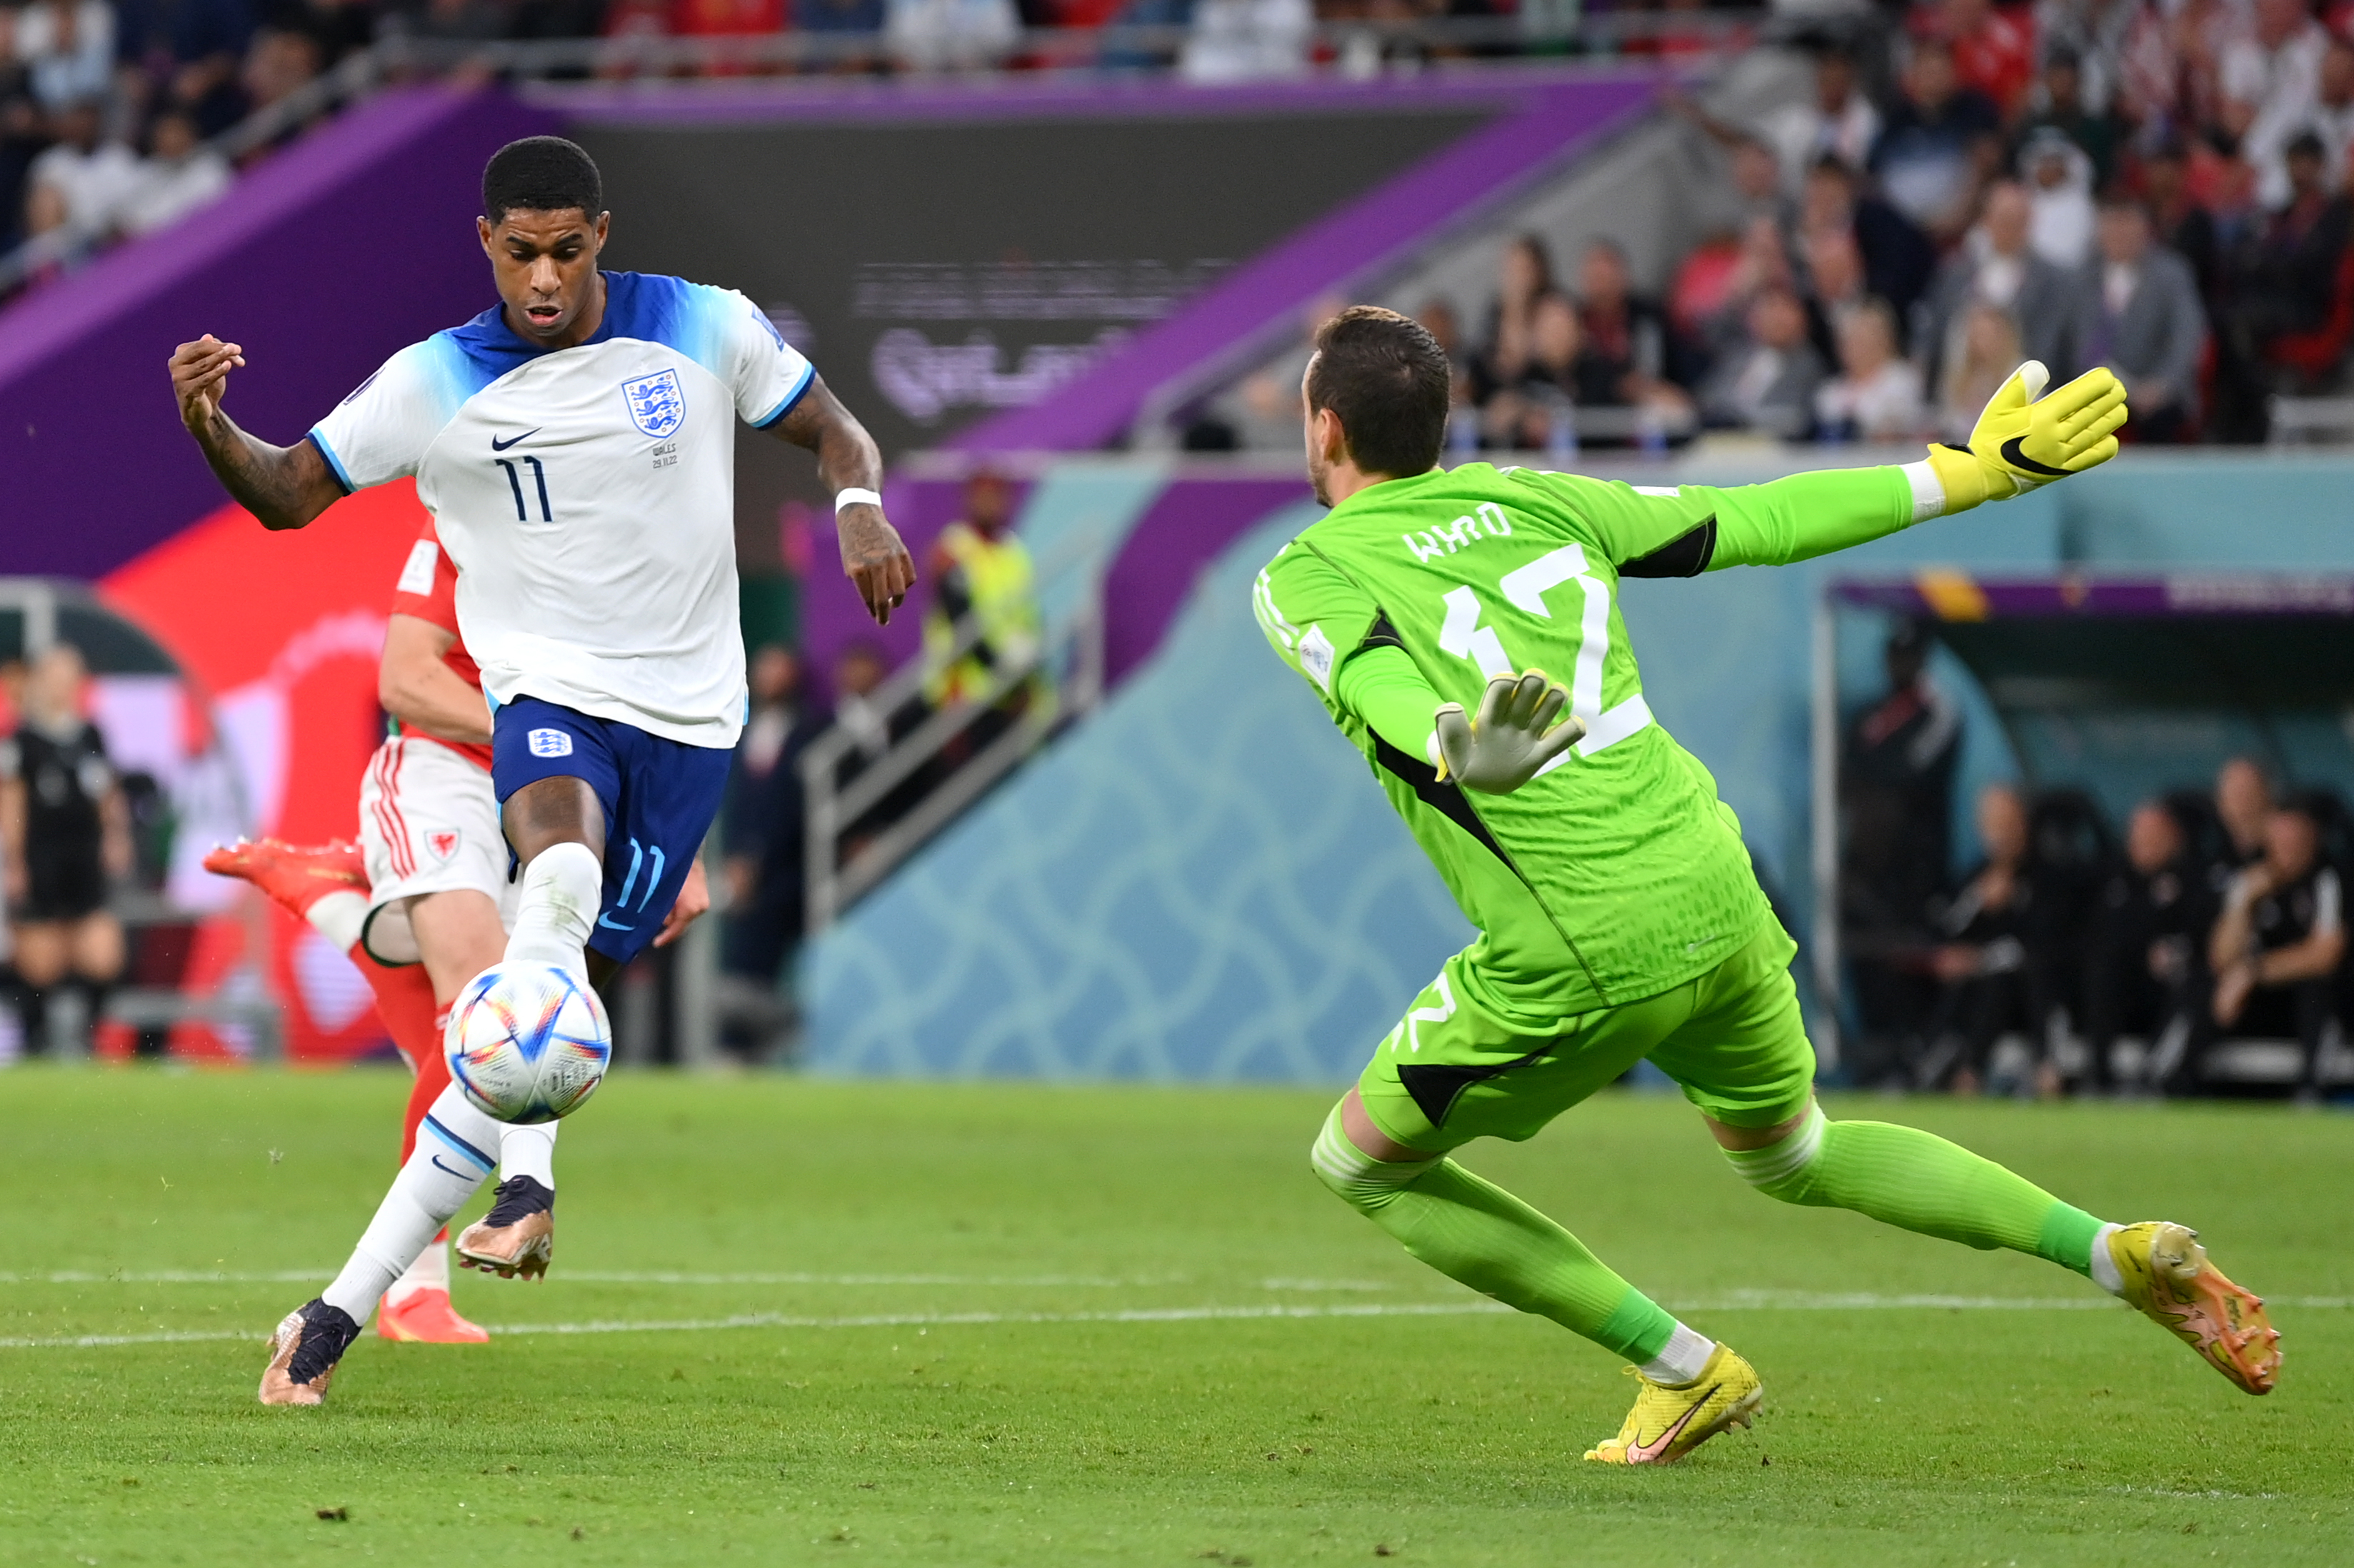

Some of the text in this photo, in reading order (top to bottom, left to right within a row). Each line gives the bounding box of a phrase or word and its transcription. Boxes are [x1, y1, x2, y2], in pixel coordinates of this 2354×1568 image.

[652, 443, 677, 456] WALES
[494, 455, 553, 523] 11
[1402, 502, 1512, 563] WARD
[1436, 542, 1653, 779] 12
[616, 837, 666, 913] 11
